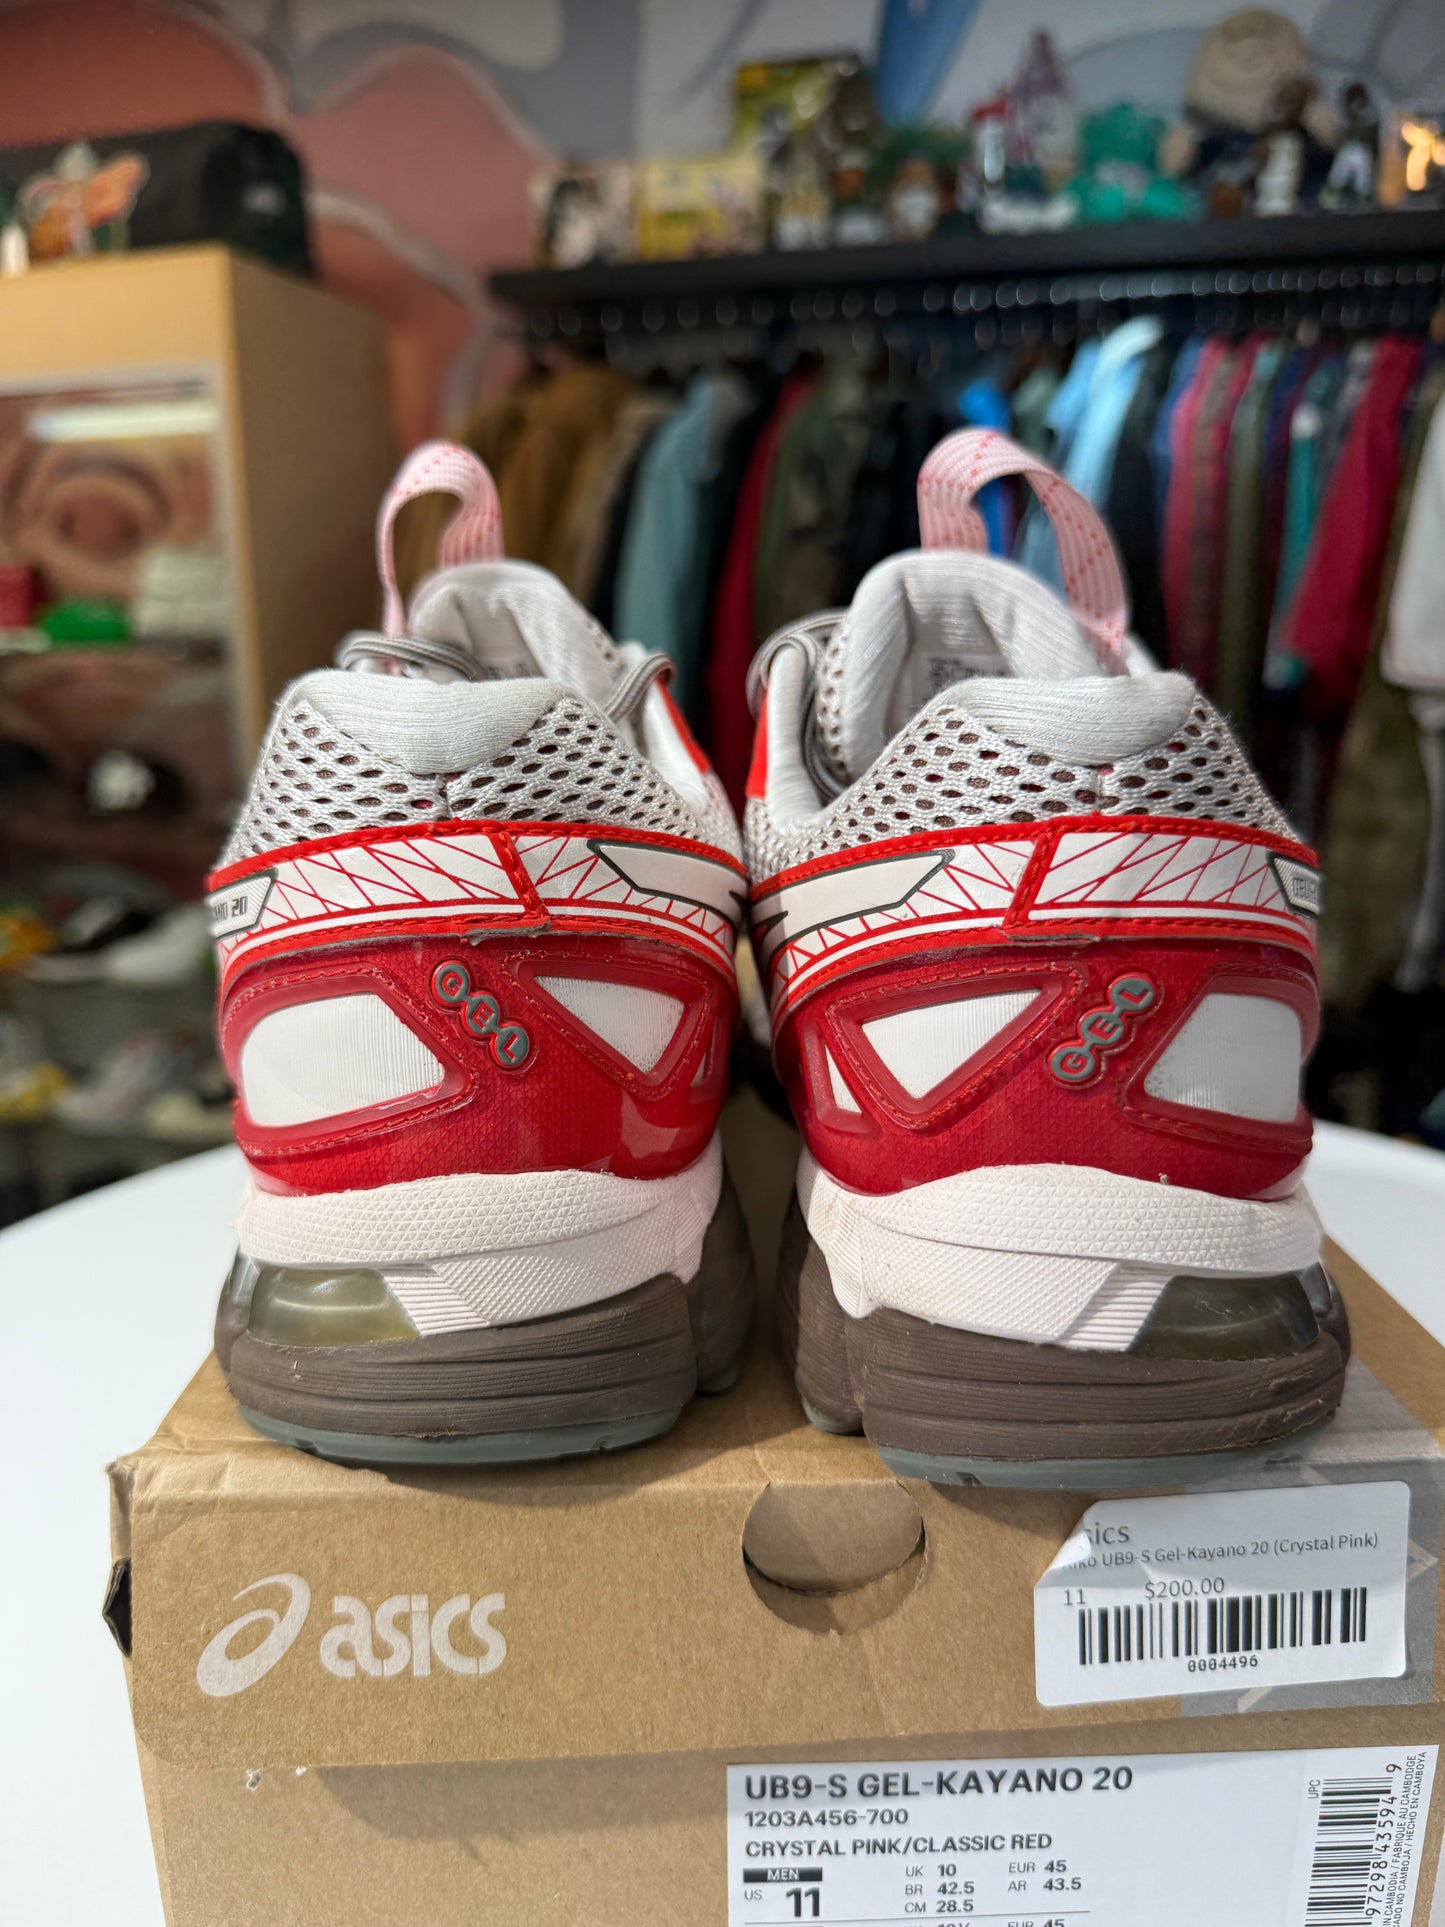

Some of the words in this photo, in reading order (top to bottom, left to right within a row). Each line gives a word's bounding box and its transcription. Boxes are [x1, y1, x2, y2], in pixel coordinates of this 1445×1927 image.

[232, 896, 248, 918] 20
[440, 967, 523, 1063] GEL
[1057, 986, 1151, 1077] GEL
[1083, 1522, 1130, 1545] sics
[1102, 1550, 1151, 1567] UB9-S
[1154, 1542, 1246, 1563] Gel-Kayano
[1251, 1541, 1269, 1556] 20
[1273, 1535, 1335, 1557] (Crystal
[1339, 1532, 1379, 1551] Pink)
[1063, 1588, 1086, 1606] 11
[1144, 1577, 1226, 1600] $200.00
[319, 1591, 507, 1678] asics
[1187, 1655, 1259, 1673] 0004496
[745, 1773, 848, 1800] UB9-S
[857, 1767, 1084, 1798] GEL-KAYANO
[1092, 1765, 1133, 1791] 20
[1400, 1755, 1417, 1806] CAMBODGE
[1412, 1751, 1427, 1796] CAMBOYA
[1307, 1779, 1321, 1800] UPC
[1398, 1807, 1409, 1819] AU
[1409, 1797, 1419, 1809] EN
[744, 1808, 909, 1828] 1203A456-700
[1405, 1811, 1417, 1841] HECHO
[745, 1839, 847, 1858] CRYSTAL
[852, 1834, 1006, 1856] PINK/CLASSIC
[1011, 1833, 1052, 1850] RED
[1392, 1821, 1407, 1863] FABRIQUE
[767, 1867, 799, 1881] MEN
[905, 1865, 924, 1877] UK
[937, 1863, 957, 1877] 10
[1008, 1861, 1036, 1874] EUR
[1043, 1859, 1068, 1873] 45
[1398, 1848, 1412, 1891] CAMBOJA
[904, 1884, 924, 1896] BR
[937, 1880, 975, 1895] 42.5
[1007, 1880, 1027, 1892] AR
[1043, 1877, 1082, 1891] 43.5
[1384, 1871, 1399, 1916] CAMBODIA
[744, 1888, 763, 1901] US
[785, 1887, 820, 1918] 11
[904, 1901, 926, 1913] CM
[936, 1899, 974, 1913] 28.5
[1396, 1893, 1405, 1905] NO
[1382, 1917, 1392, 1926] IN
